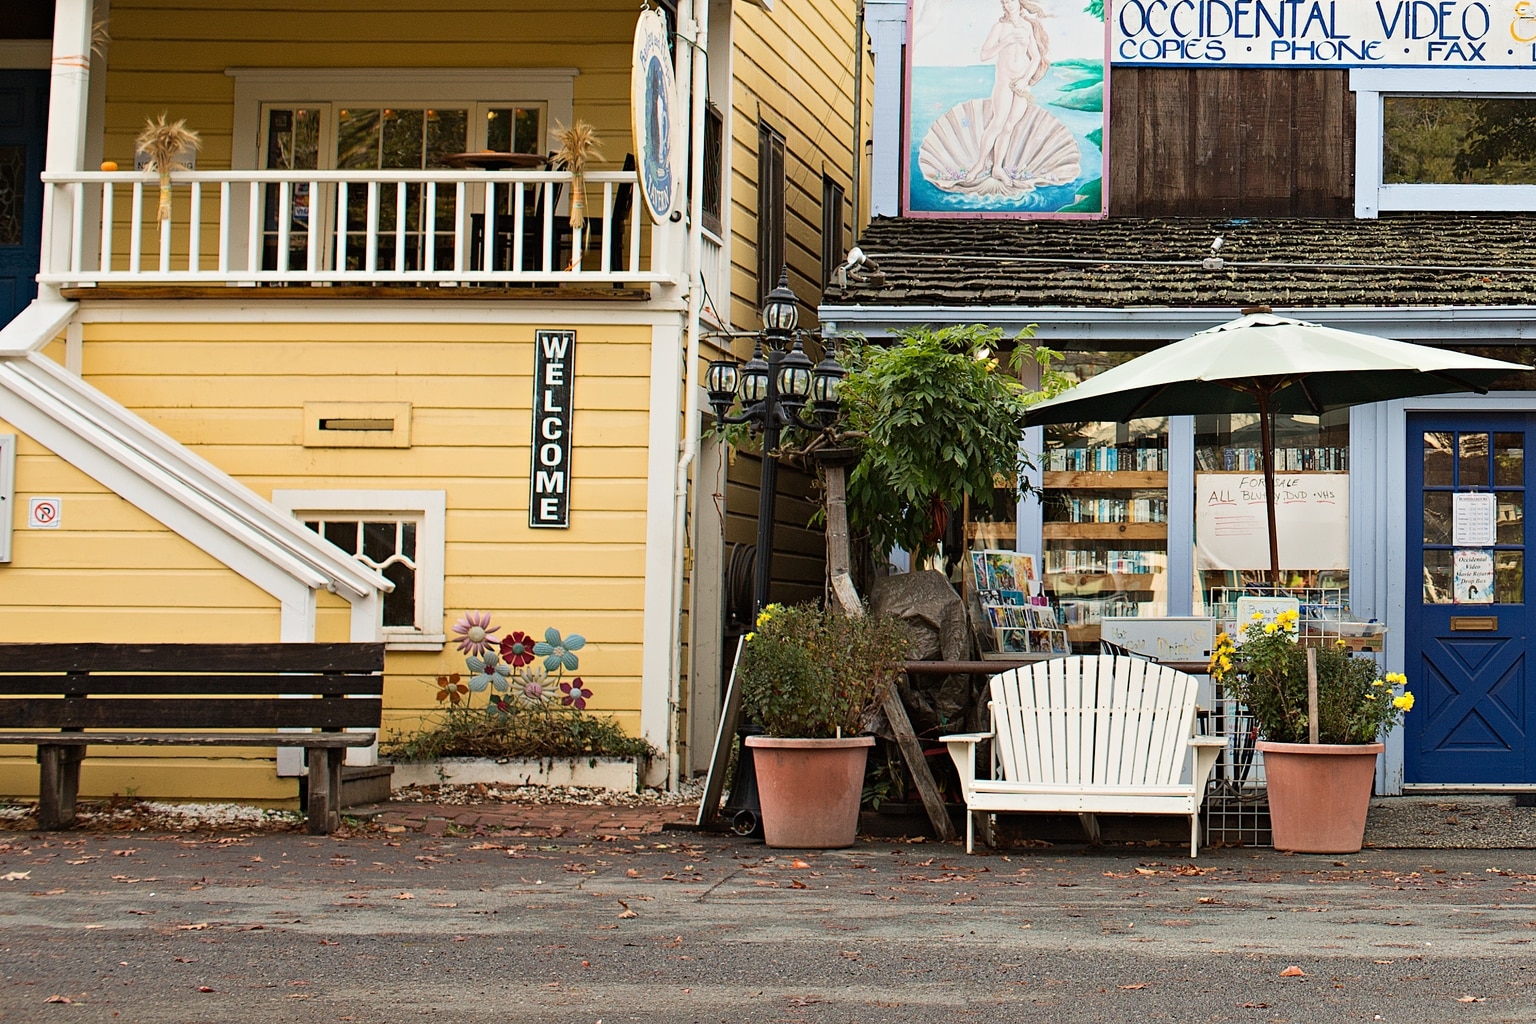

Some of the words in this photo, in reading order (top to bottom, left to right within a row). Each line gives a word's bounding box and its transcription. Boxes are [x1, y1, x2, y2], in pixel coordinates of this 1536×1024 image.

[1119, 0, 1350, 39] OCCIDENTAL
[1376, 0, 1490, 40] VIDEO
[1119, 39, 1226, 61] COPIES
[1271, 39, 1385, 61] PHONE
[1428, 41, 1486, 62] FAX
[535, 336, 569, 521] WELCOME
[1274, 478, 1300, 488] SALE
[1208, 490, 1235, 503] ALL
